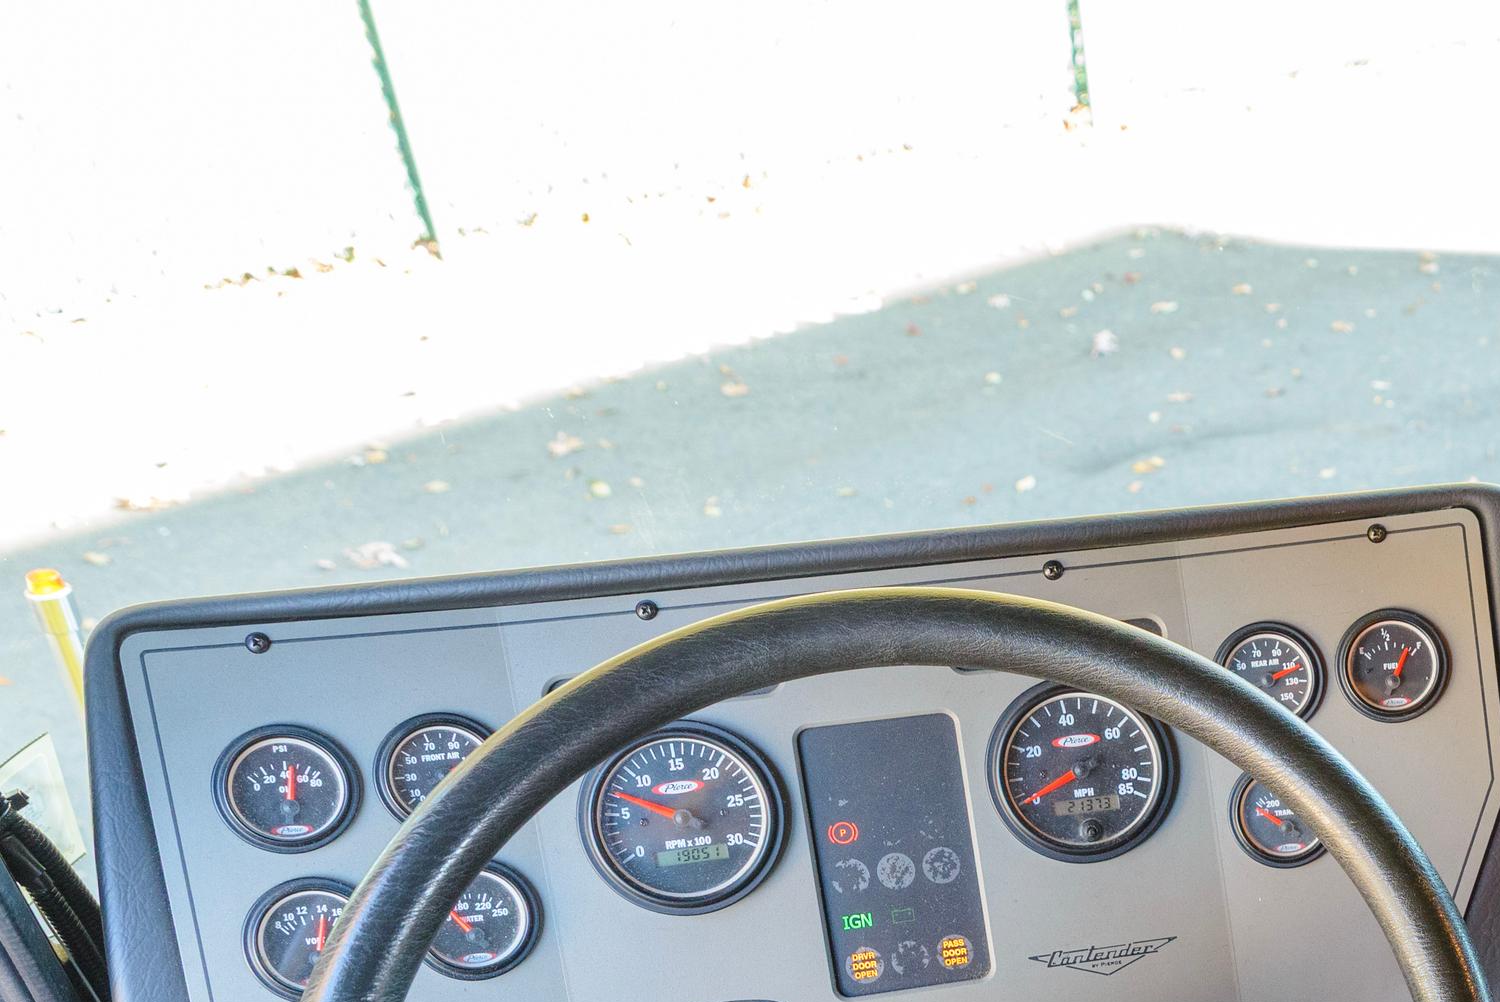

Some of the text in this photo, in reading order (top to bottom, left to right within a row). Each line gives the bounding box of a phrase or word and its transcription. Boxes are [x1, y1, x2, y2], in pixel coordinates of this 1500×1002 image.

[1285, 677, 1298, 685] 130
[1280, 692, 1294, 700] 150
[1058, 714, 1074, 726] 40
[1104, 727, 1120, 740] 60
[272, 745, 287, 753] PSI
[424, 743, 435, 751] 70
[1026, 746, 1041, 758] 20
[405, 757, 417, 765] 50
[421, 752, 460, 762] FRONT AIR
[668, 758, 685, 771] 15
[702, 767, 719, 780] 20
[1122, 768, 1137, 780] 80
[263, 775, 276, 784] 20
[297, 775, 309, 783] 60
[310, 779, 322, 787] 80
[636, 775, 651, 787] 10
[254, 784, 260, 792] 0
[664, 782, 693, 792] Pierce
[1118, 782, 1134, 795] 85
[410, 789, 420, 797] 10
[1074, 788, 1094, 798] MPH
[727, 794, 743, 808] 25
[621, 808, 630, 819] 5
[665, 838, 686, 850] RPM
[695, 836, 712, 846] 100
[726, 833, 743, 846] 30
[636, 846, 645, 857] 0
[296, 906, 307, 914] 12
[316, 905, 328, 913] 14
[475, 902, 491, 910] 220
[283, 913, 294, 921] 10
[492, 908, 508, 917] 250
[275, 921, 281, 929] 8
[842, 912, 873, 930] IGN
[943, 938, 965, 948] PASS
[851, 951, 875, 961] DRVR
[942, 948, 967, 958] DOOR
[1048, 943, 1154, 968] Contender
[852, 960, 877, 970] DOOR
[944, 956, 968, 966] OPEN
[854, 970, 878, 980] OPEN
